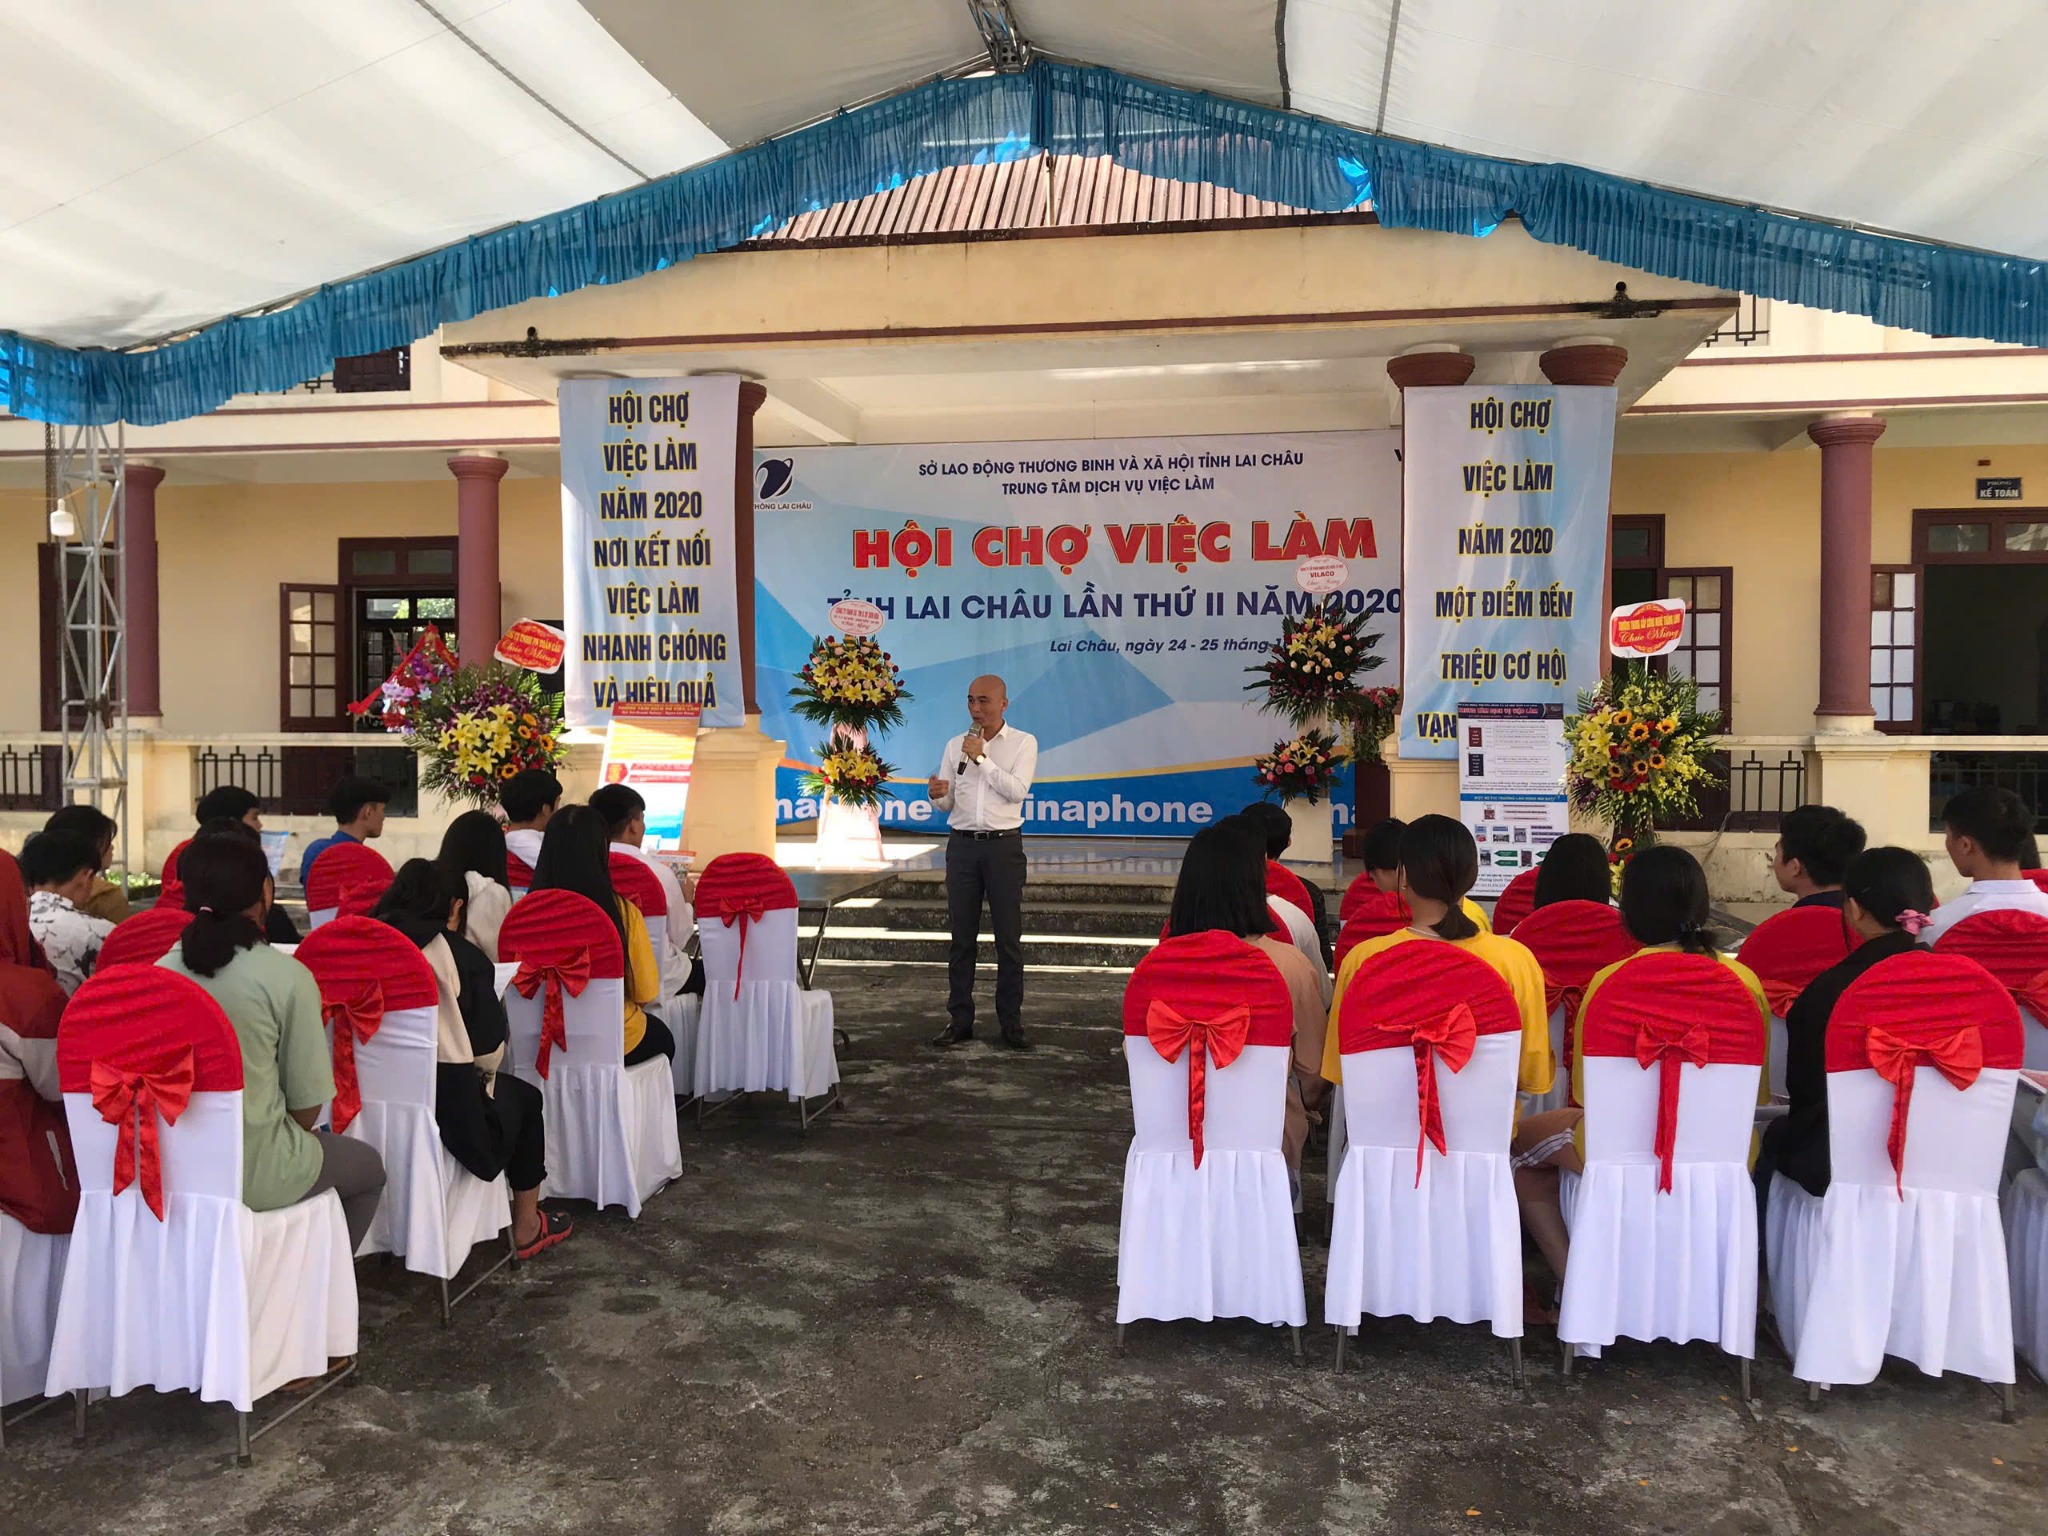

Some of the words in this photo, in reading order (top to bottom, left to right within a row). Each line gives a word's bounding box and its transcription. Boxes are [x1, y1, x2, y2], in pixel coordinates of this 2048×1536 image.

[609, 390, 642, 430] HỘI
[649, 391, 690, 429] CHỢ
[1470, 397, 1504, 434] HỘI
[1510, 399, 1552, 434] CHỢ
[603, 438, 648, 478] VIỆC
[654, 437, 698, 471] LÀM
[918, 459, 938, 476] SỞ
[941, 463, 969, 475] LAO
[972, 459, 1015, 478] ĐỘNG
[1018, 458, 1077, 473] THƯƠNG
[1081, 459, 1115, 472] BINH
[1119, 454, 1139, 471] VÀ
[1143, 454, 1164, 470] XÃ
[1168, 453, 1194, 472] HỘI
[1198, 452, 1230, 468] TỈNH
[1235, 453, 1257, 467] LAI
[1260, 450, 1304, 467] CHÂU
[1002, 482, 1048, 495] TRUNG
[1051, 478, 1081, 494] TÂM
[1084, 479, 1120, 496] DỊCH
[1124, 478, 1144, 495] VỤ
[1148, 476, 1182, 495] VIỆC
[1185, 475, 1215, 491] LÀM
[1463, 460, 1507, 497] VIỆC
[1512, 458, 1554, 491] LÀM
[1994, 486, 2019, 497] TOÁN
[600, 486, 648, 519] NĂM
[654, 491, 702, 519] 2020
[754, 501, 776, 510] HÔNG
[594, 538, 629, 567] NƠI
[635, 530, 671, 567] KẾT
[676, 529, 711, 567] NỐI
[852, 518, 954, 579] HỘI
[972, 523, 1092, 577] CHỢ
[1103, 513, 1232, 575] VIỆC
[1251, 510, 1379, 562] LÀM
[1458, 522, 1504, 555] NĂM
[1510, 527, 1554, 554] 2020
[1310, 570, 1335, 578] VILACO
[607, 581, 651, 621] VIỆC
[657, 580, 700, 614] LÀM
[905, 595, 950, 620] LAI
[961, 588, 1052, 620] CHÂU
[1063, 581, 1123, 618] LẦN
[1134, 584, 1196, 617] THỨ
[1206, 591, 1224, 617] II
[1236, 584, 1313, 616] NĂM
[1435, 585, 1477, 623] MỘT
[1481, 580, 1534, 617] ĐIỂM
[1539, 580, 1573, 618] ĐẾN
[583, 633, 652, 662] NHANH
[658, 627, 727, 662] CHÓNG
[1050, 639, 1072, 653] Lai
[1075, 638, 1120, 656] Châu,
[1124, 638, 1165, 656] ngày
[1168, 639, 1187, 651] 24
[1201, 638, 1219, 651] 25
[1223, 636, 1269, 653] tháng
[1440, 647, 1497, 686] TRIỆU
[1502, 651, 1531, 681] CƠ
[1536, 647, 1567, 687] HỘI
[593, 675, 619, 708] VÀ
[625, 675, 671, 704] HIỆU
[677, 671, 717, 708] QUẢ
[1417, 712, 1457, 744] VẠN
[1024, 793, 1213, 829] inaphone
